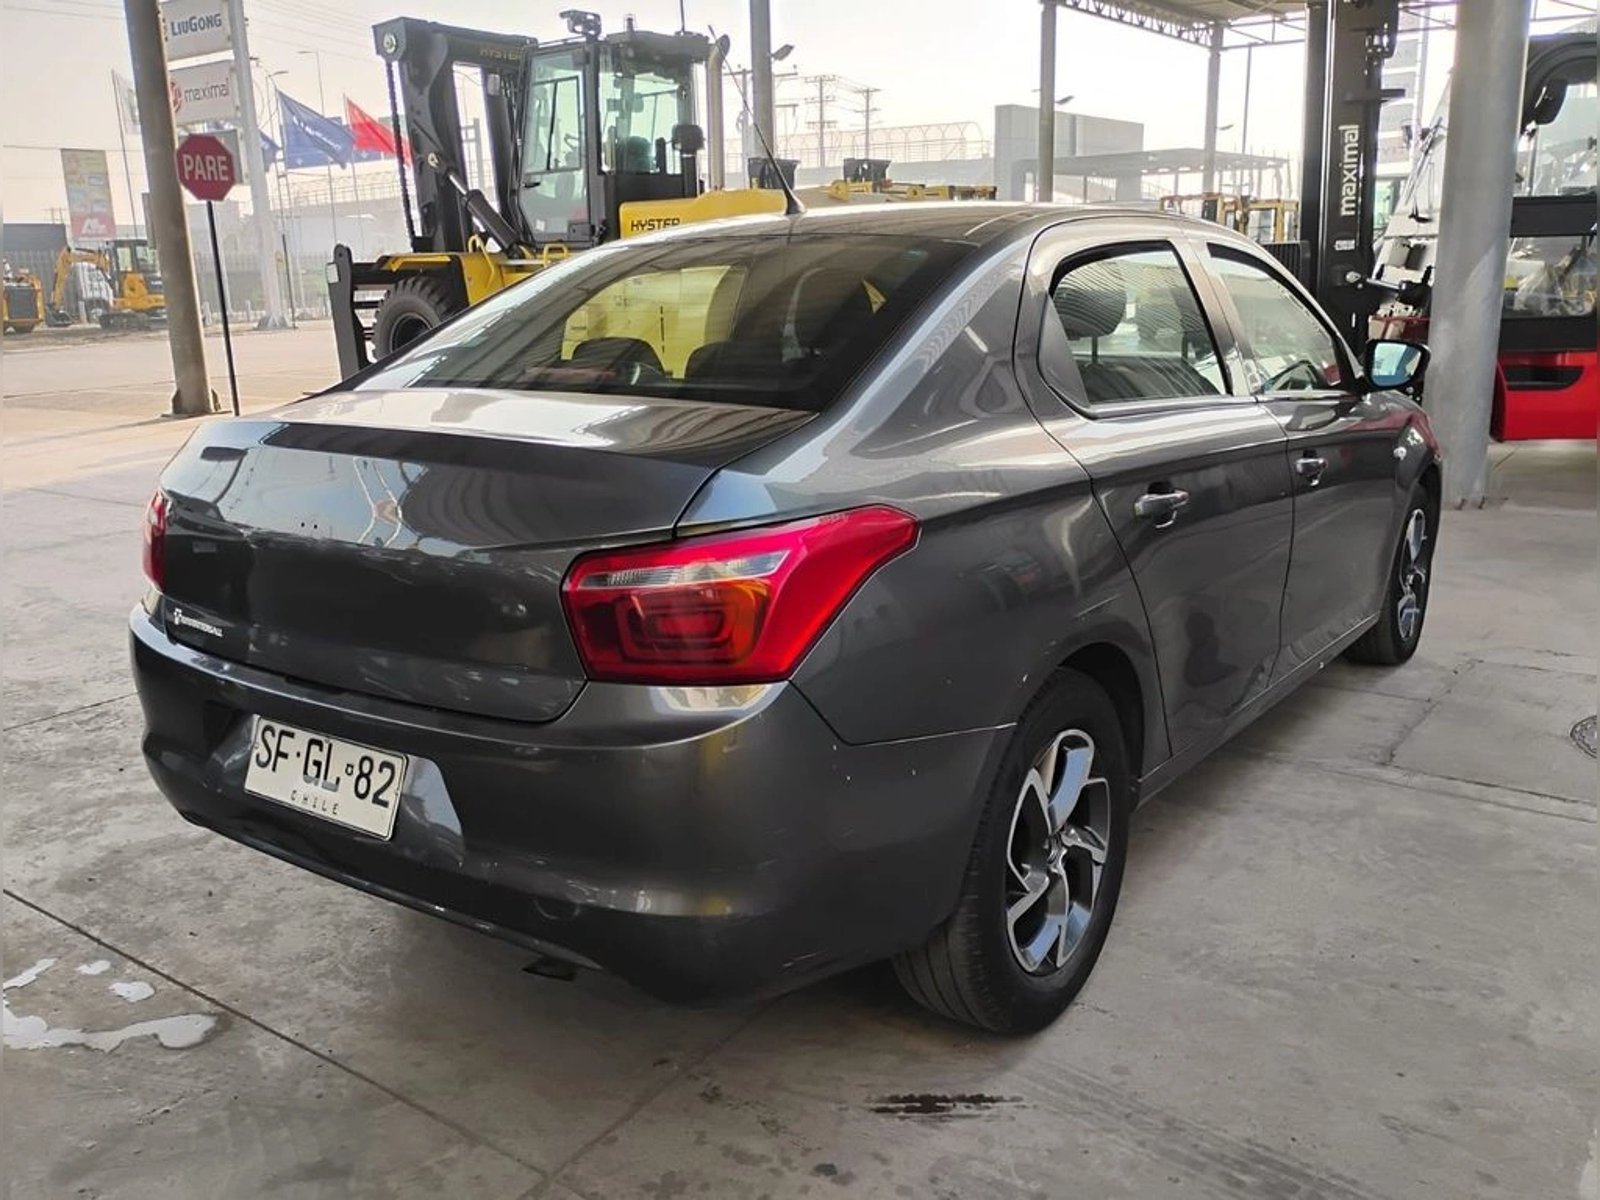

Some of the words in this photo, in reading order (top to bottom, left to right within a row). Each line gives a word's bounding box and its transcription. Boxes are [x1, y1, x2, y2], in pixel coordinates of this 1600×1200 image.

[184, 77, 230, 103] maximal
[182, 153, 229, 182] PARE
[1338, 124, 1360, 217] maximal
[630, 217, 681, 232] HYSTER
[290, 789, 339, 816] CHILE
